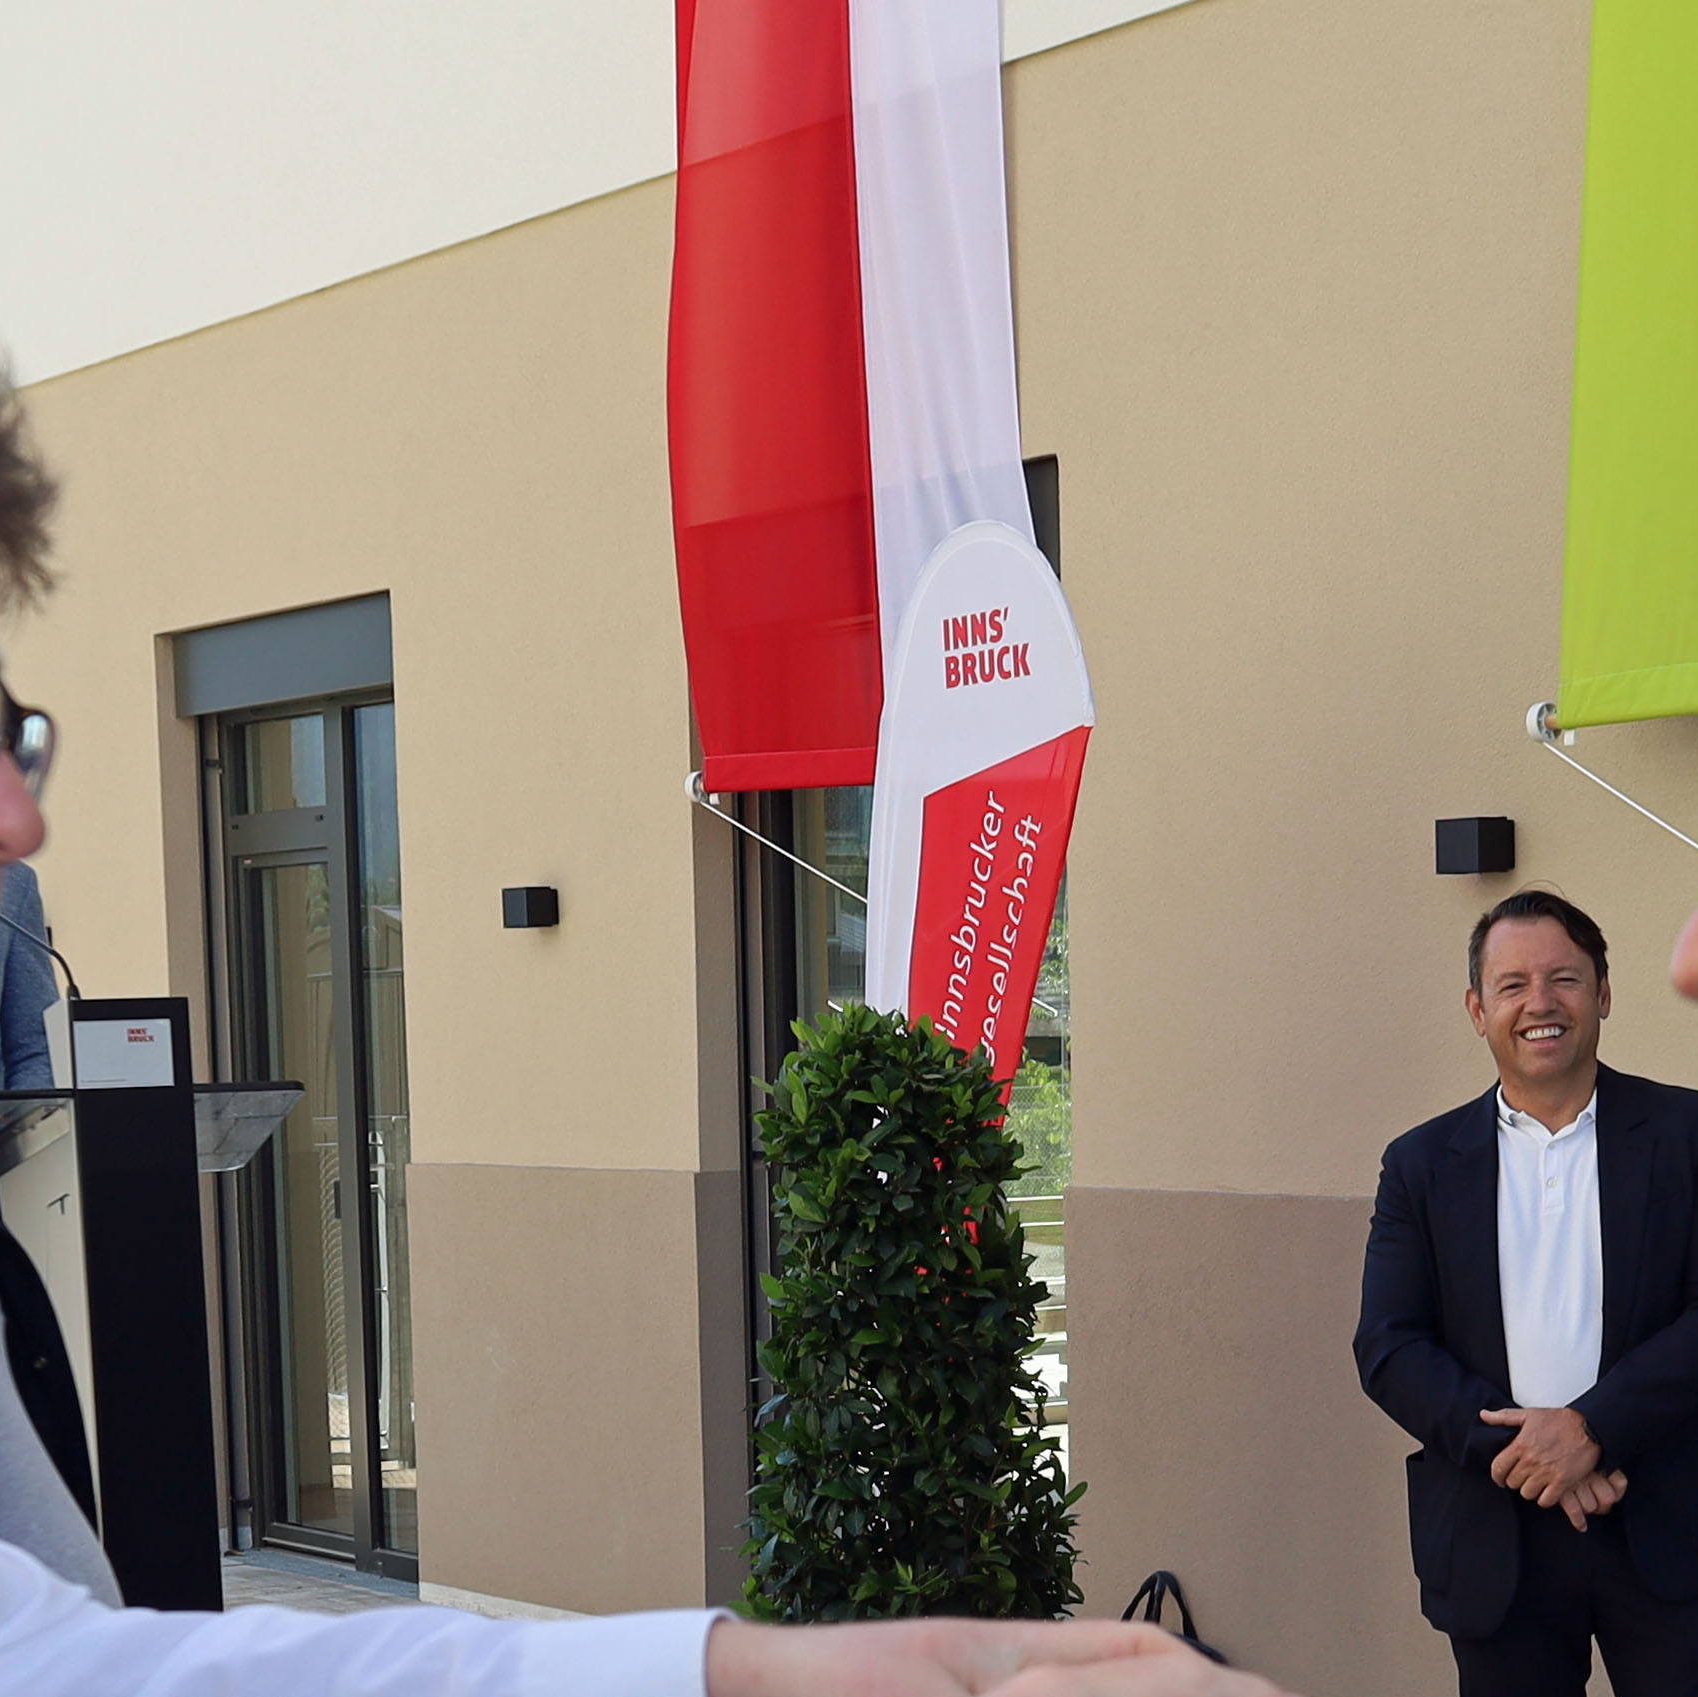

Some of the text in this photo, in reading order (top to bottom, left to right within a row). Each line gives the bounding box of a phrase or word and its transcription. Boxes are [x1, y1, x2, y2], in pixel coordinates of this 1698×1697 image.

[942, 605, 1009, 652] INNS'
[944, 642, 1031, 689] BRUCK
[934, 790, 1005, 1041] Innsbrucker
